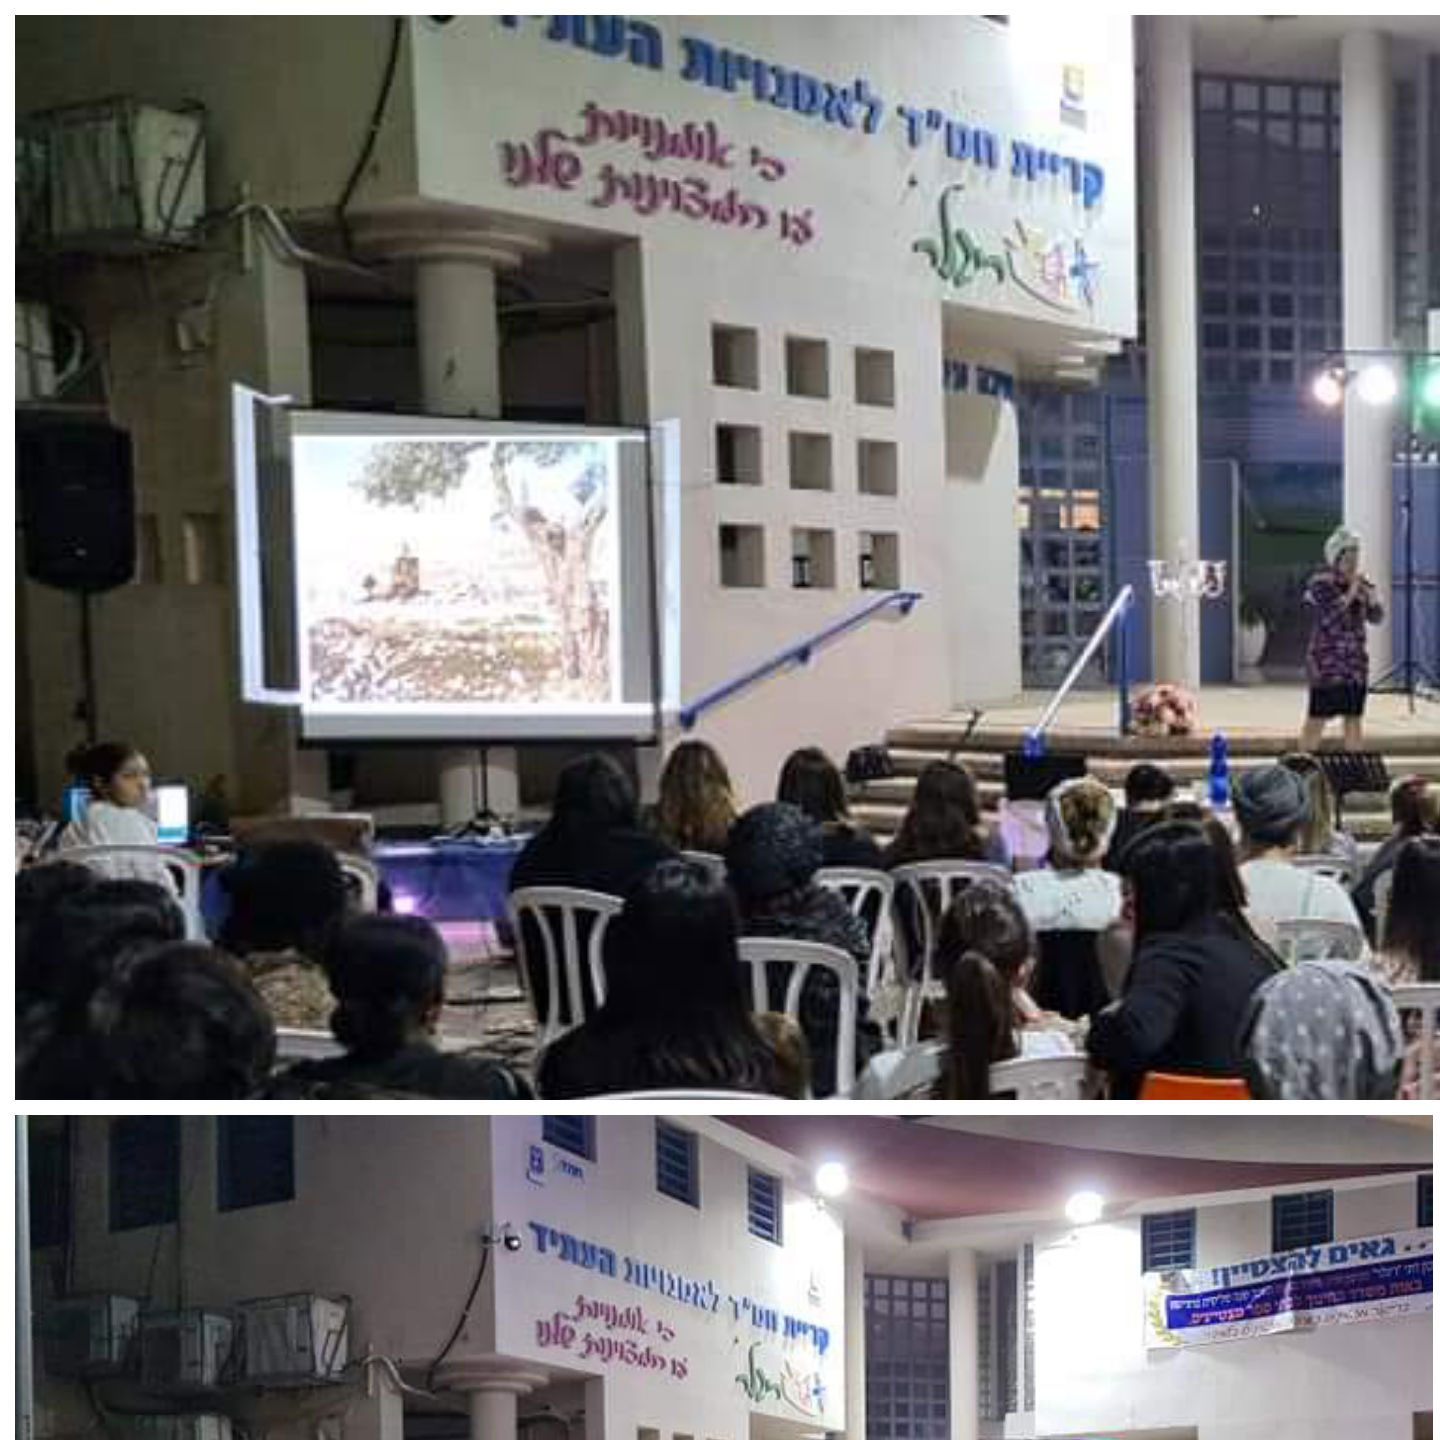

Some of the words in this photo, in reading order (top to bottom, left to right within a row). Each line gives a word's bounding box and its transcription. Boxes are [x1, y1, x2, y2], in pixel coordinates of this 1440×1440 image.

[1010, 139, 1104, 210] קריית
[528, 1220, 617, 1278] העתיד
[1328, 1237, 1396, 1264] גאים
